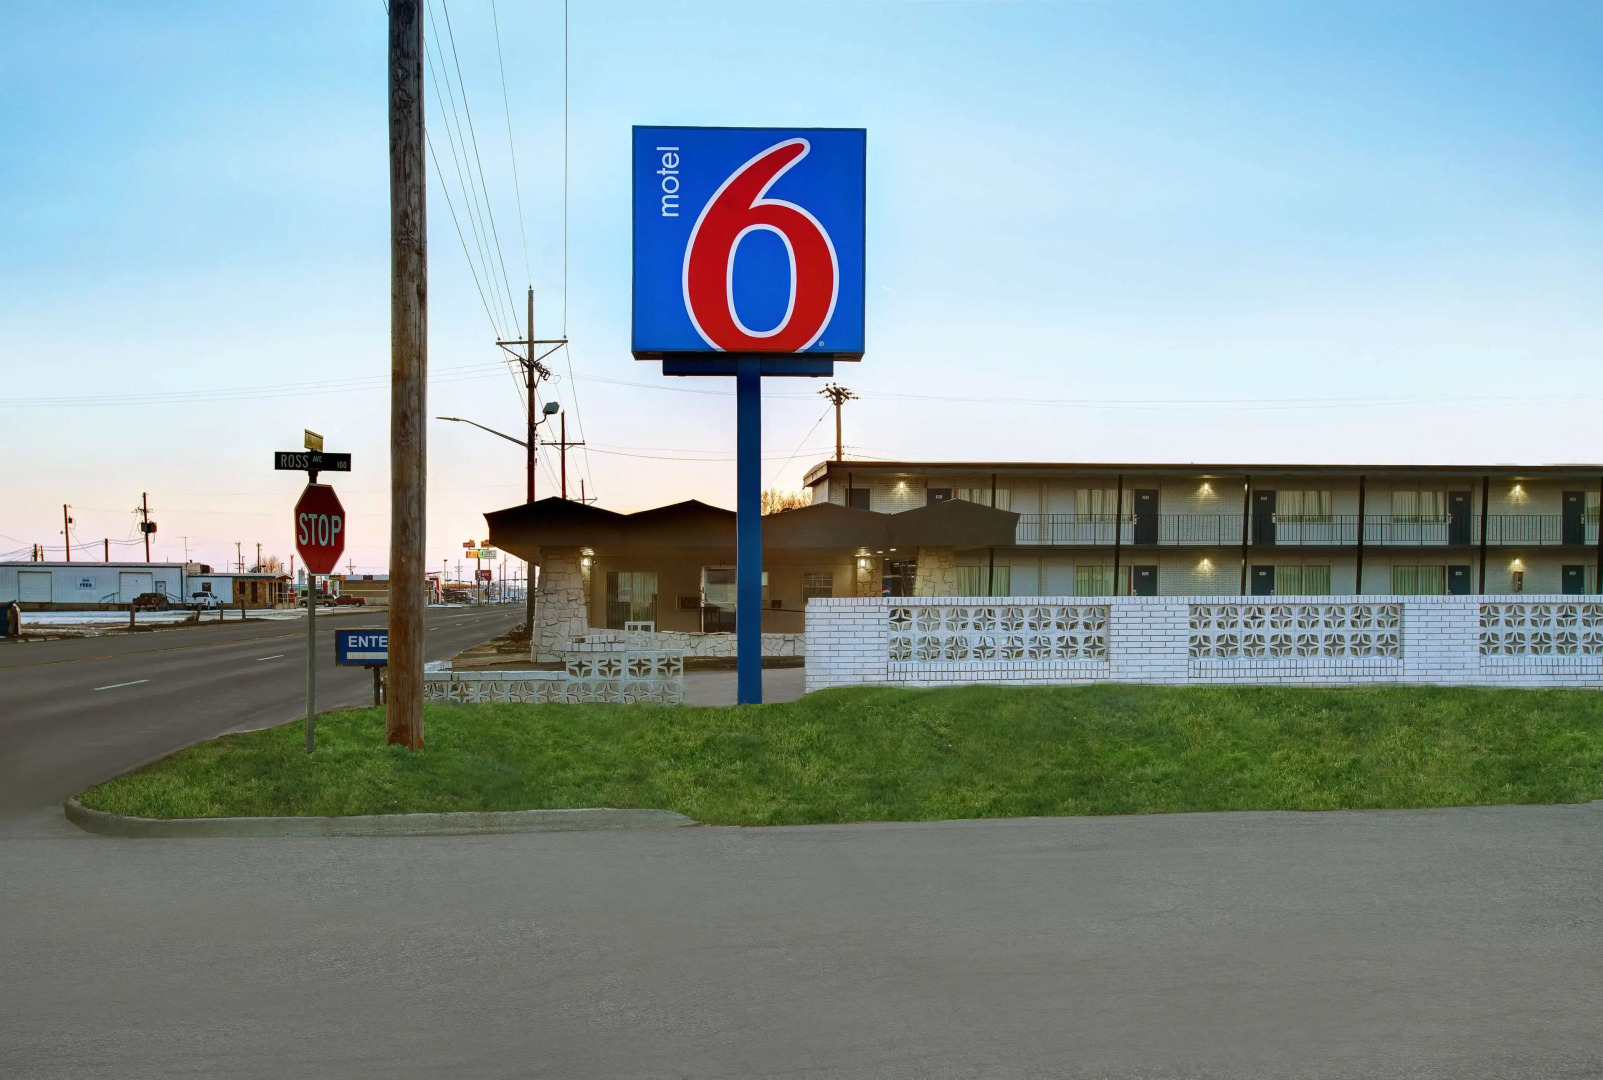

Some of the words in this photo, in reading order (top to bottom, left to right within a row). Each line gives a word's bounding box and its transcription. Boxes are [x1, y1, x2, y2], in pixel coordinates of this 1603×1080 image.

[656, 146, 679, 217] motel
[682, 138, 840, 352] 6
[281, 454, 309, 468] ROSS
[298, 512, 342, 547] STOP
[348, 635, 388, 648] ENTE
